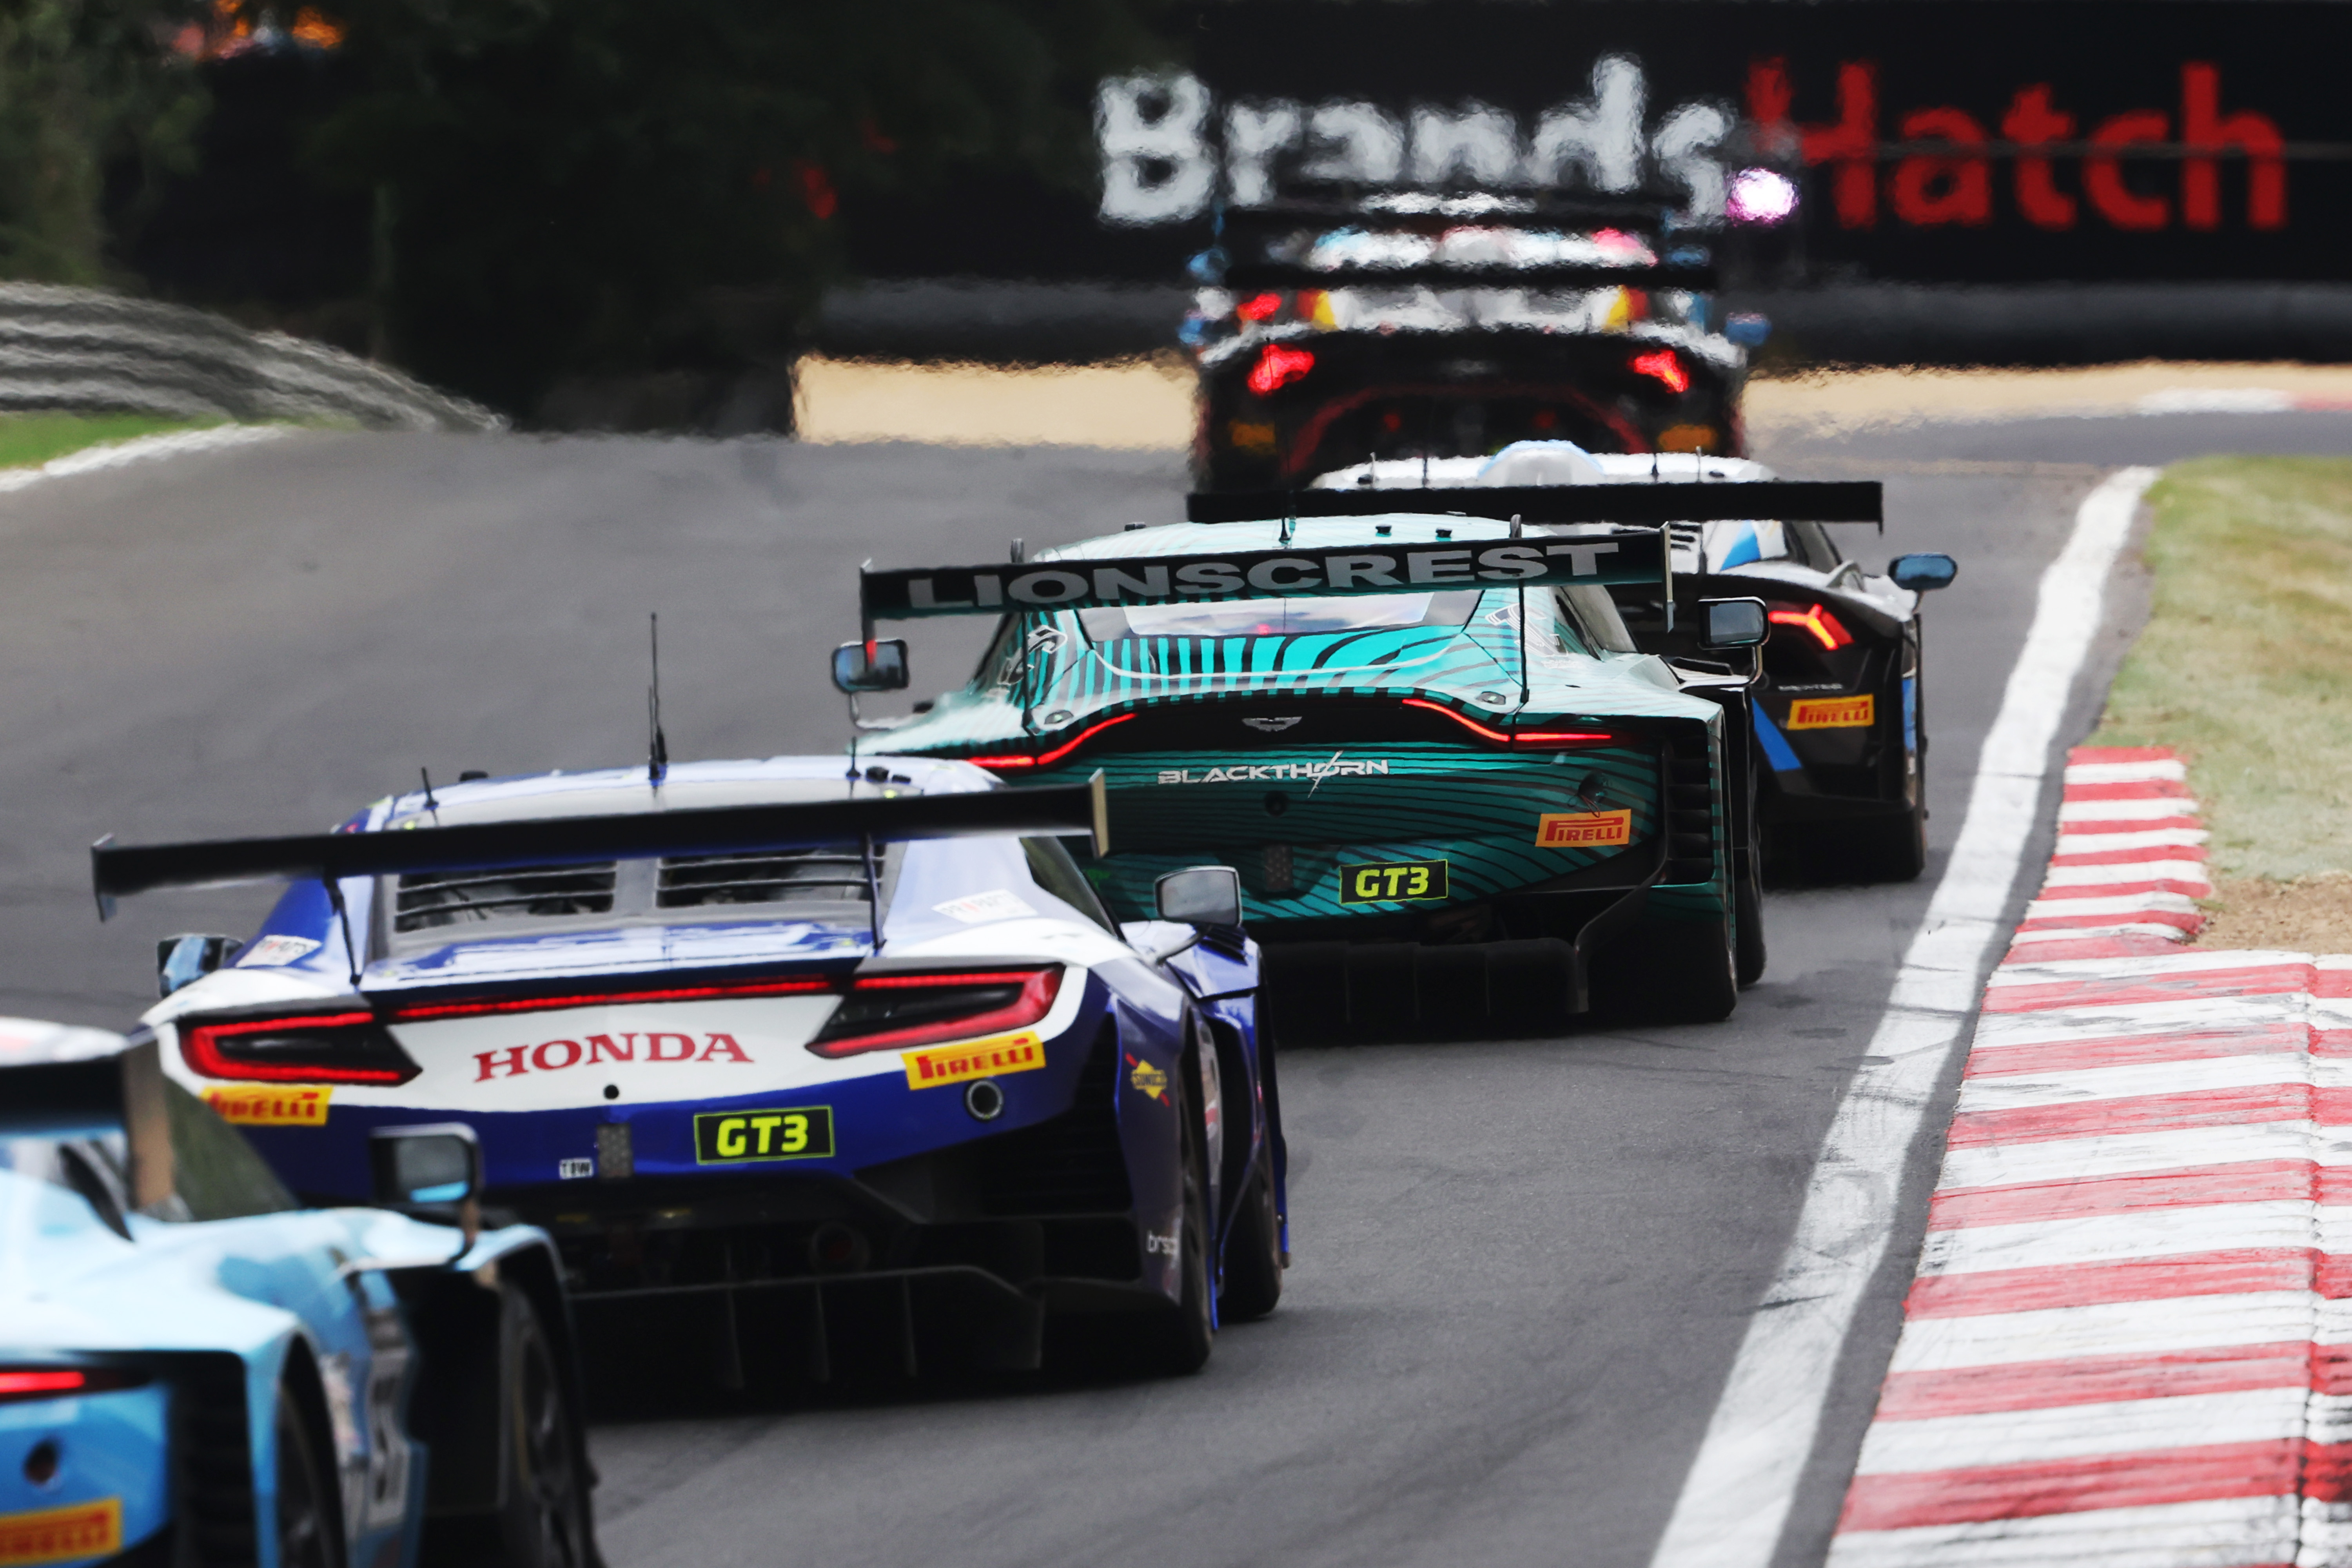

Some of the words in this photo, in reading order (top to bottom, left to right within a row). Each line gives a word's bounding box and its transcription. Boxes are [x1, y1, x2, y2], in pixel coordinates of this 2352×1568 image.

[1096, 53, 1737, 227] Brands
[1744, 58, 2285, 228] Hatch
[909, 542, 1620, 610] LIONSCREST
[1797, 701, 1868, 724] PIRELLI
[1158, 750, 1389, 798] BLACKTHORN
[1545, 817, 1624, 841] PIRELLI
[1356, 867, 1429, 897] GT3
[473, 1032, 755, 1083] HONDA
[915, 1037, 1033, 1080] PIRELLI
[717, 1114, 808, 1157] GT3
